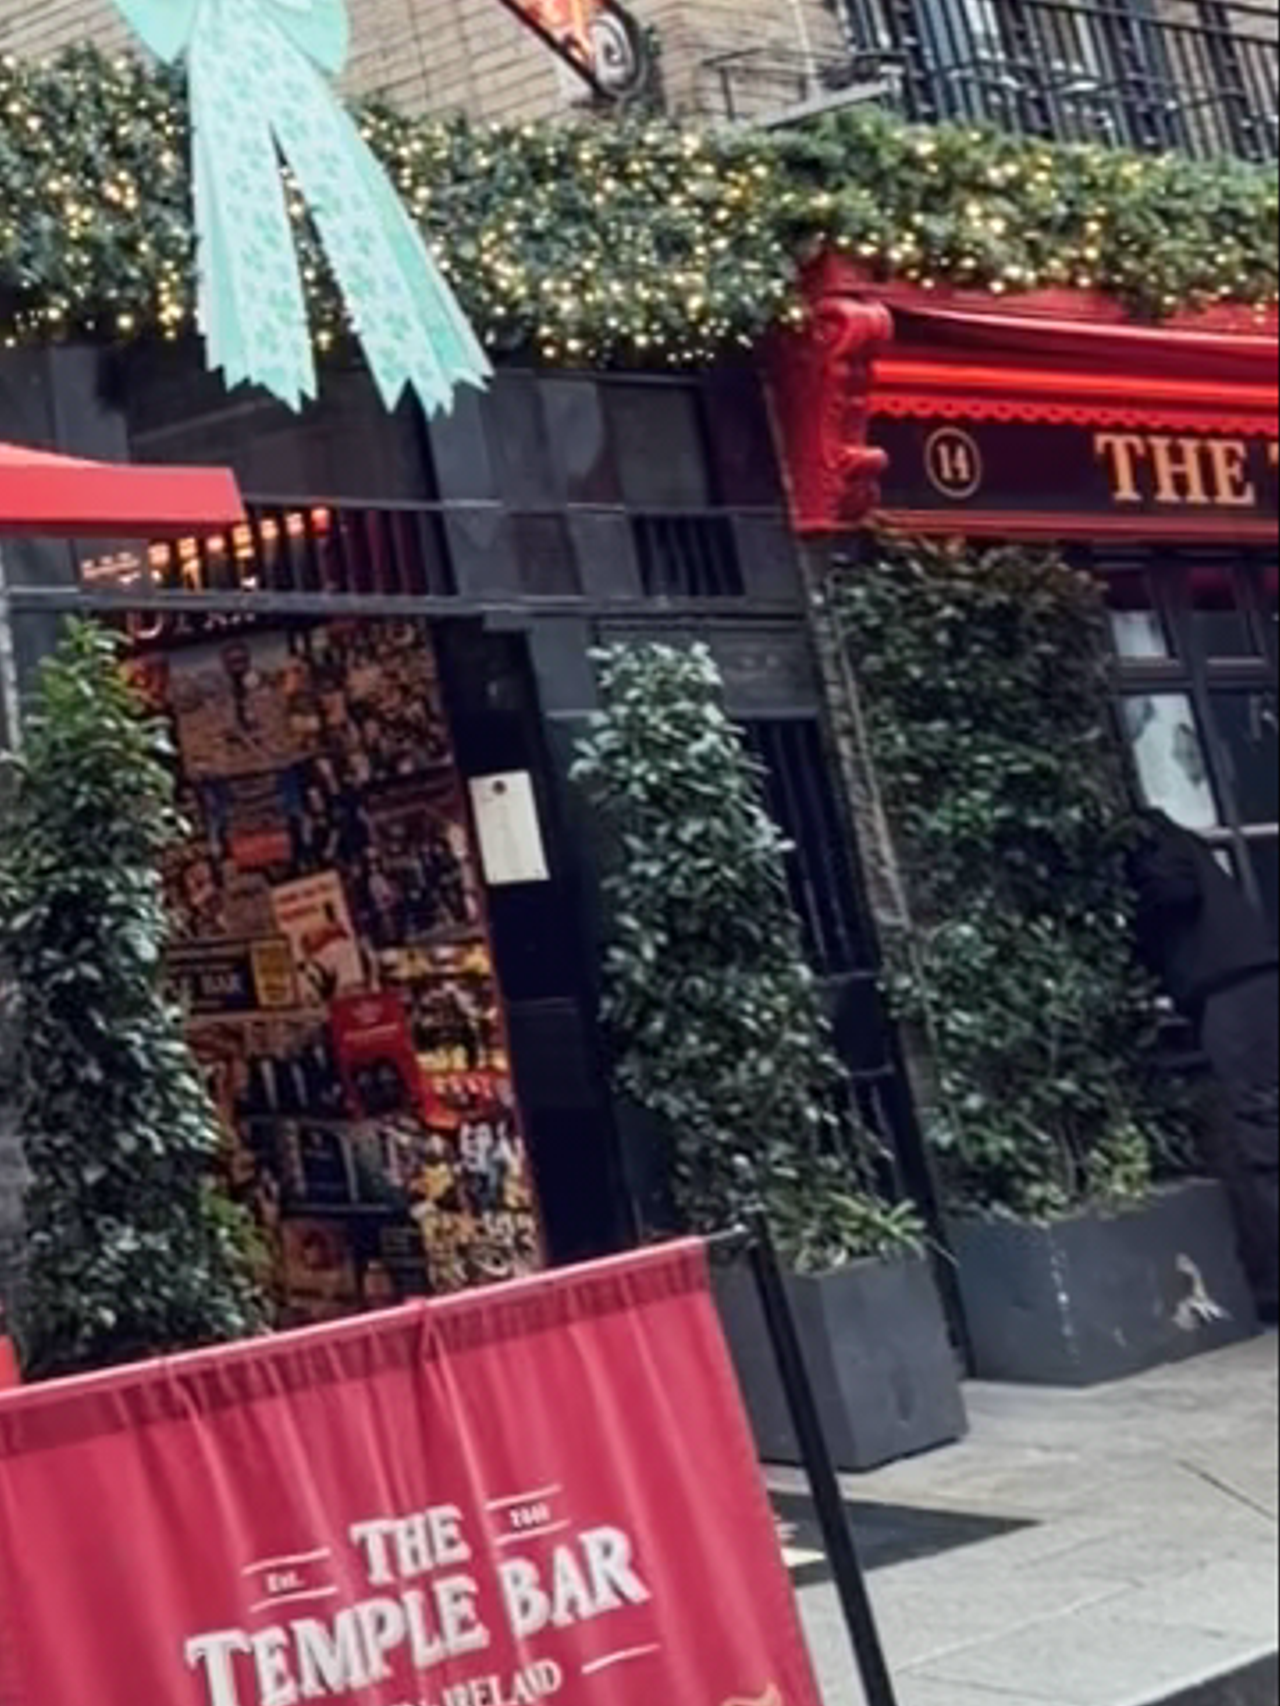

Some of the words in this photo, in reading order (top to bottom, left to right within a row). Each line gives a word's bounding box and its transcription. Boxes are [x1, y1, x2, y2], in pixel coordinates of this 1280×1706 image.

[938, 438, 972, 482] 14
[1093, 429, 1256, 507] THE
[350, 1504, 472, 1584] THE
[497, 1525, 653, 1637] BAR
